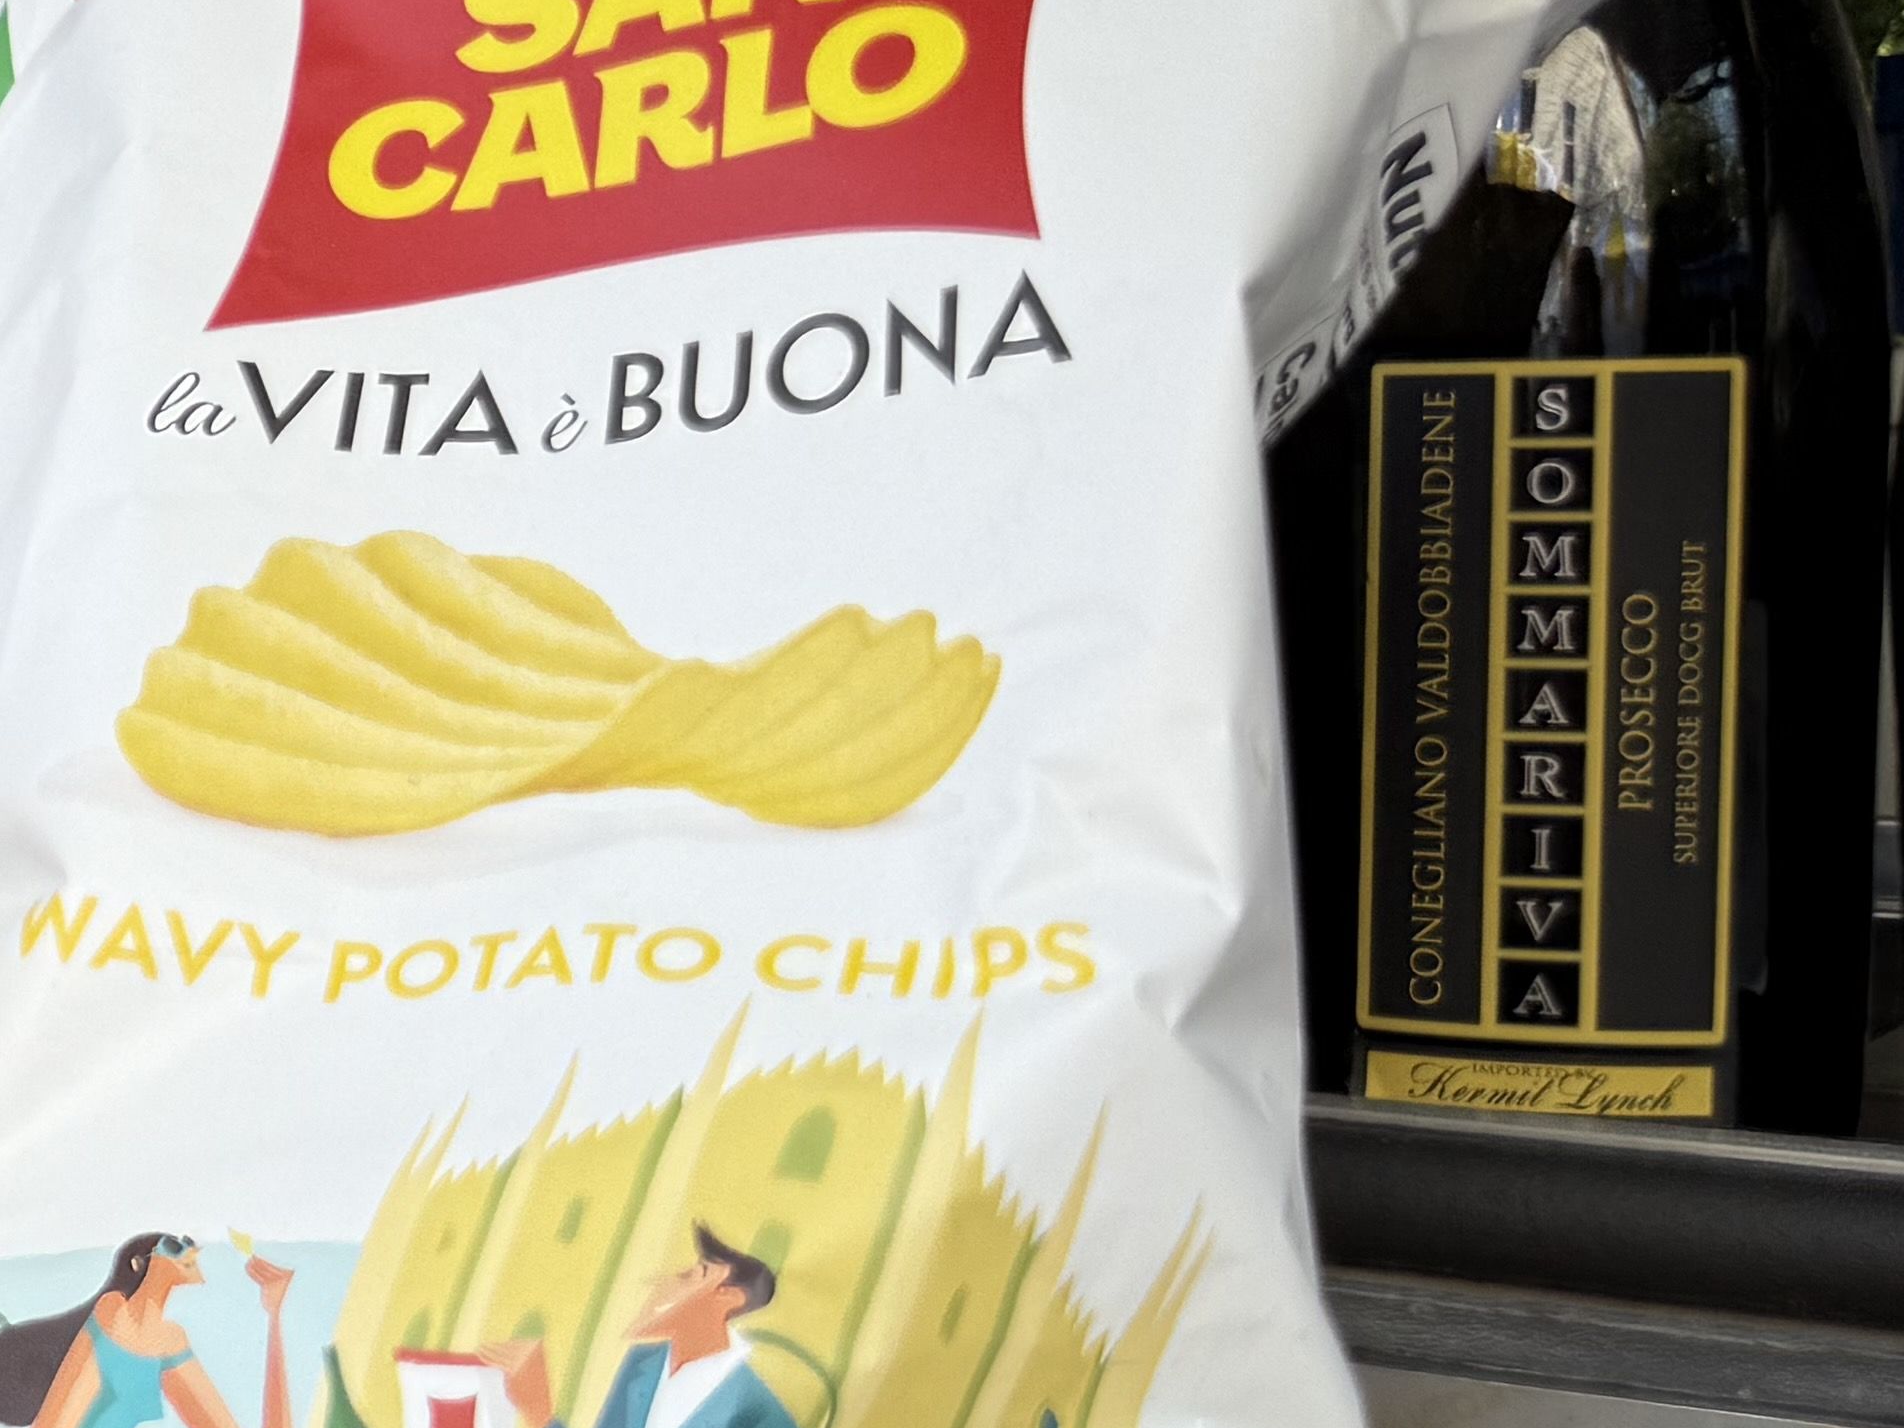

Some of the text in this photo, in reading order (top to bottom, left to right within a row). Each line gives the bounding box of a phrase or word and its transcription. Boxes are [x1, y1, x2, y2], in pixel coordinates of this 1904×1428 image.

[327, 1, 968, 221] CARLO
[147, 268, 1074, 457] la VITA è BUONA
[1408, 389, 1457, 1006] CONEGLIANO VALDOBBIADENE
[1512, 383, 1578, 1018] SOMMARIVA
[1617, 592, 1659, 813] PROSECCO
[1672, 540, 1708, 867] SUPERIORE DOCG BRUT
[19, 890, 1098, 1005] WAVY POTATO CHIPS
[1407, 1061, 1682, 1117] Kermit Lynch
[1471, 1062, 1572, 1079] IMPORTED
